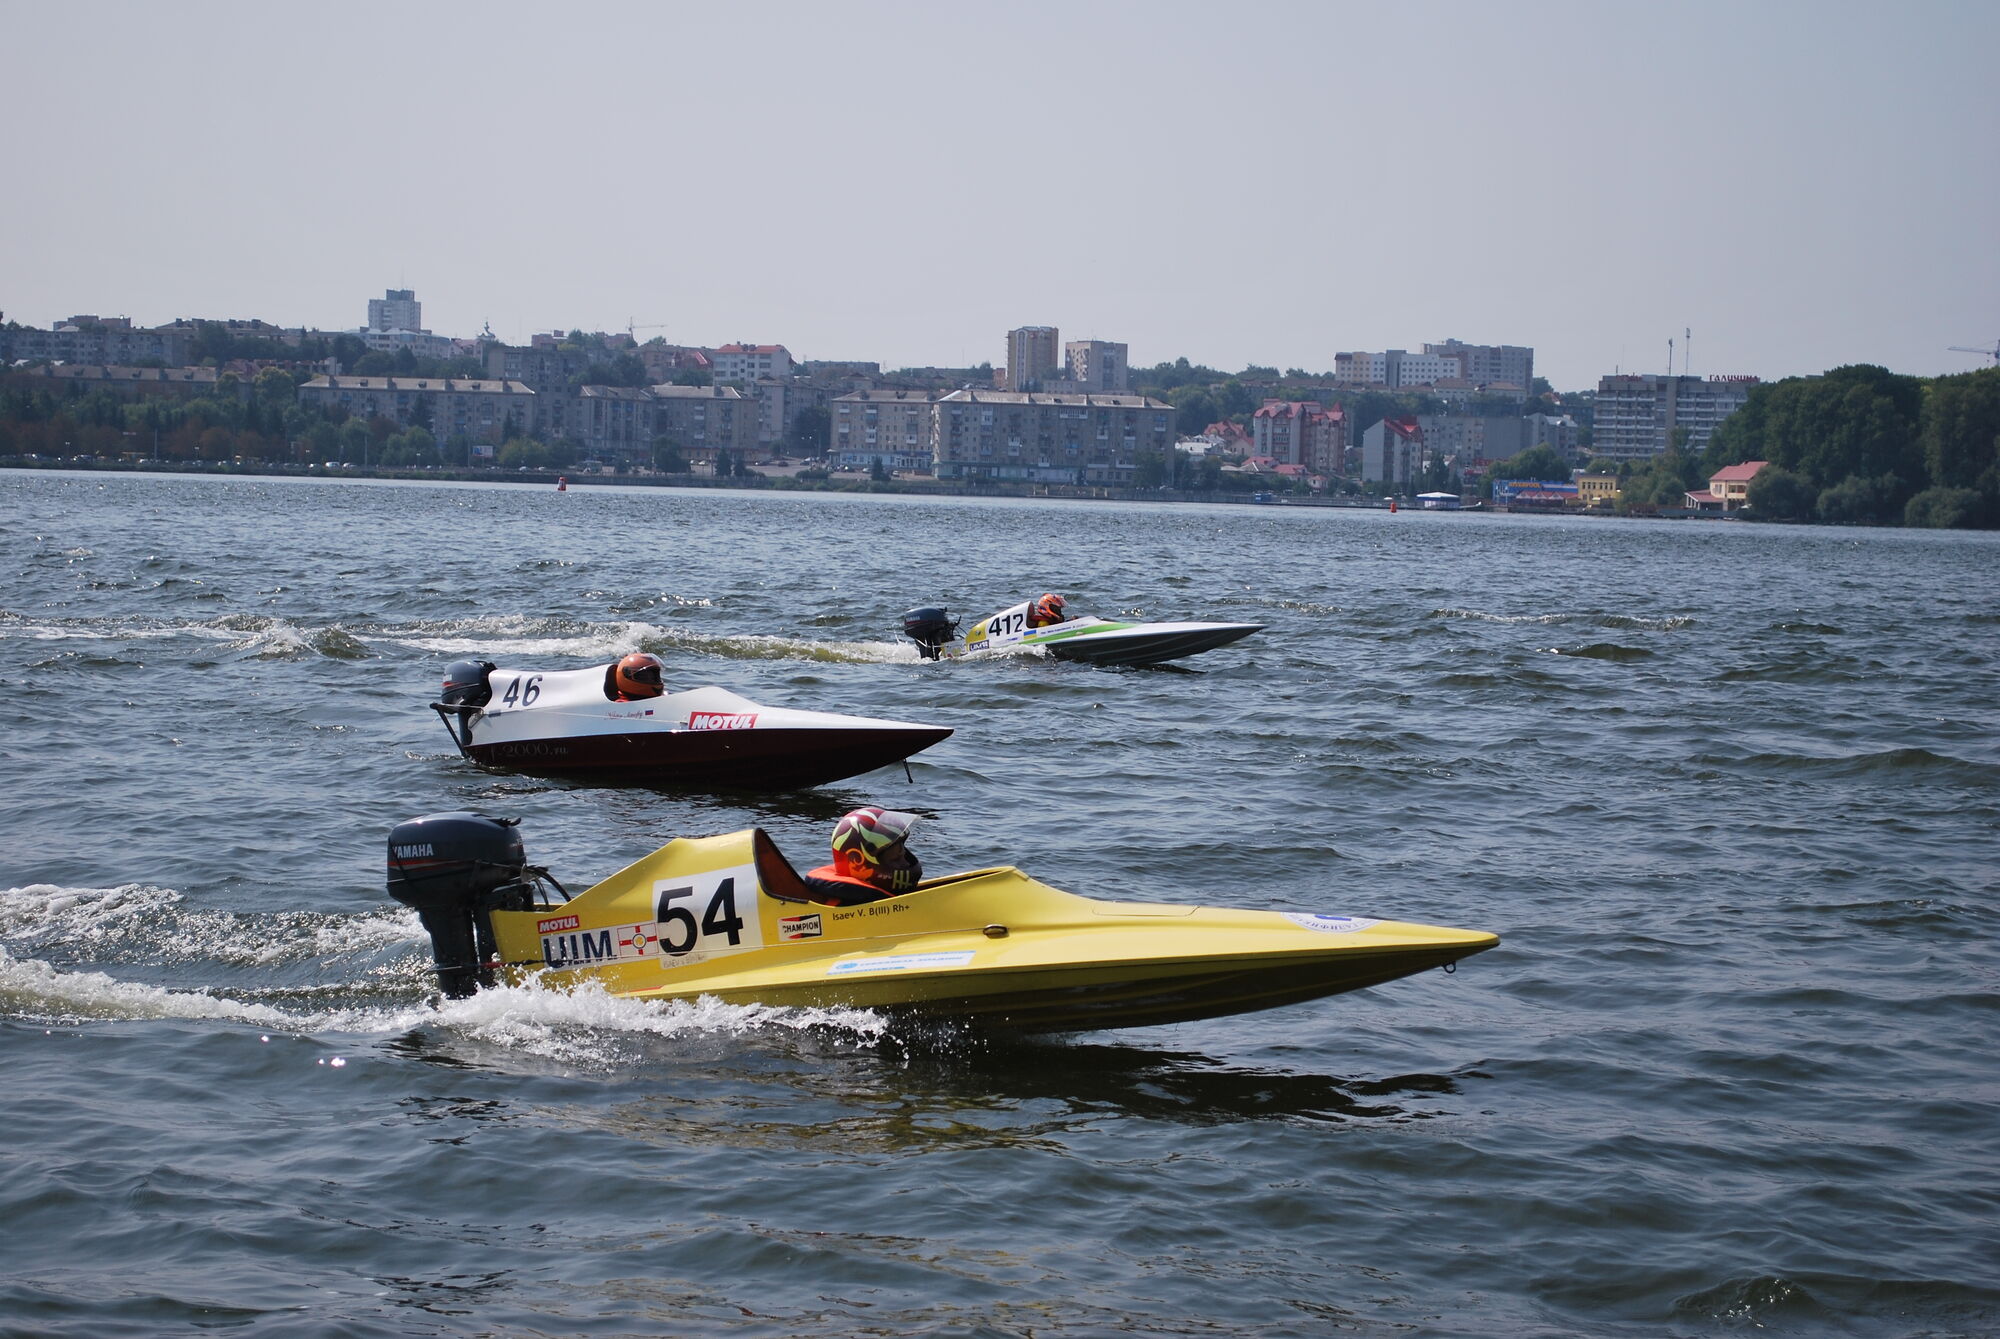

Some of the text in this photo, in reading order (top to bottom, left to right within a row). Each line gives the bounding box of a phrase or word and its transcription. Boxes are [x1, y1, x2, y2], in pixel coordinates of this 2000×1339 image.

[989, 614, 1023, 636] 412
[502, 674, 543, 708] 46
[692, 714, 753, 729] MOTUL
[392, 843, 434, 858] YAMAHA
[657, 877, 744, 957] 54
[832, 911, 855, 921] Isaev
[857, 909, 866, 917] V.
[893, 904, 910, 913] Rh+
[539, 916, 579, 931] MOTUL
[782, 921, 819, 933] CHAMPION
[543, 930, 613, 968] UIM
